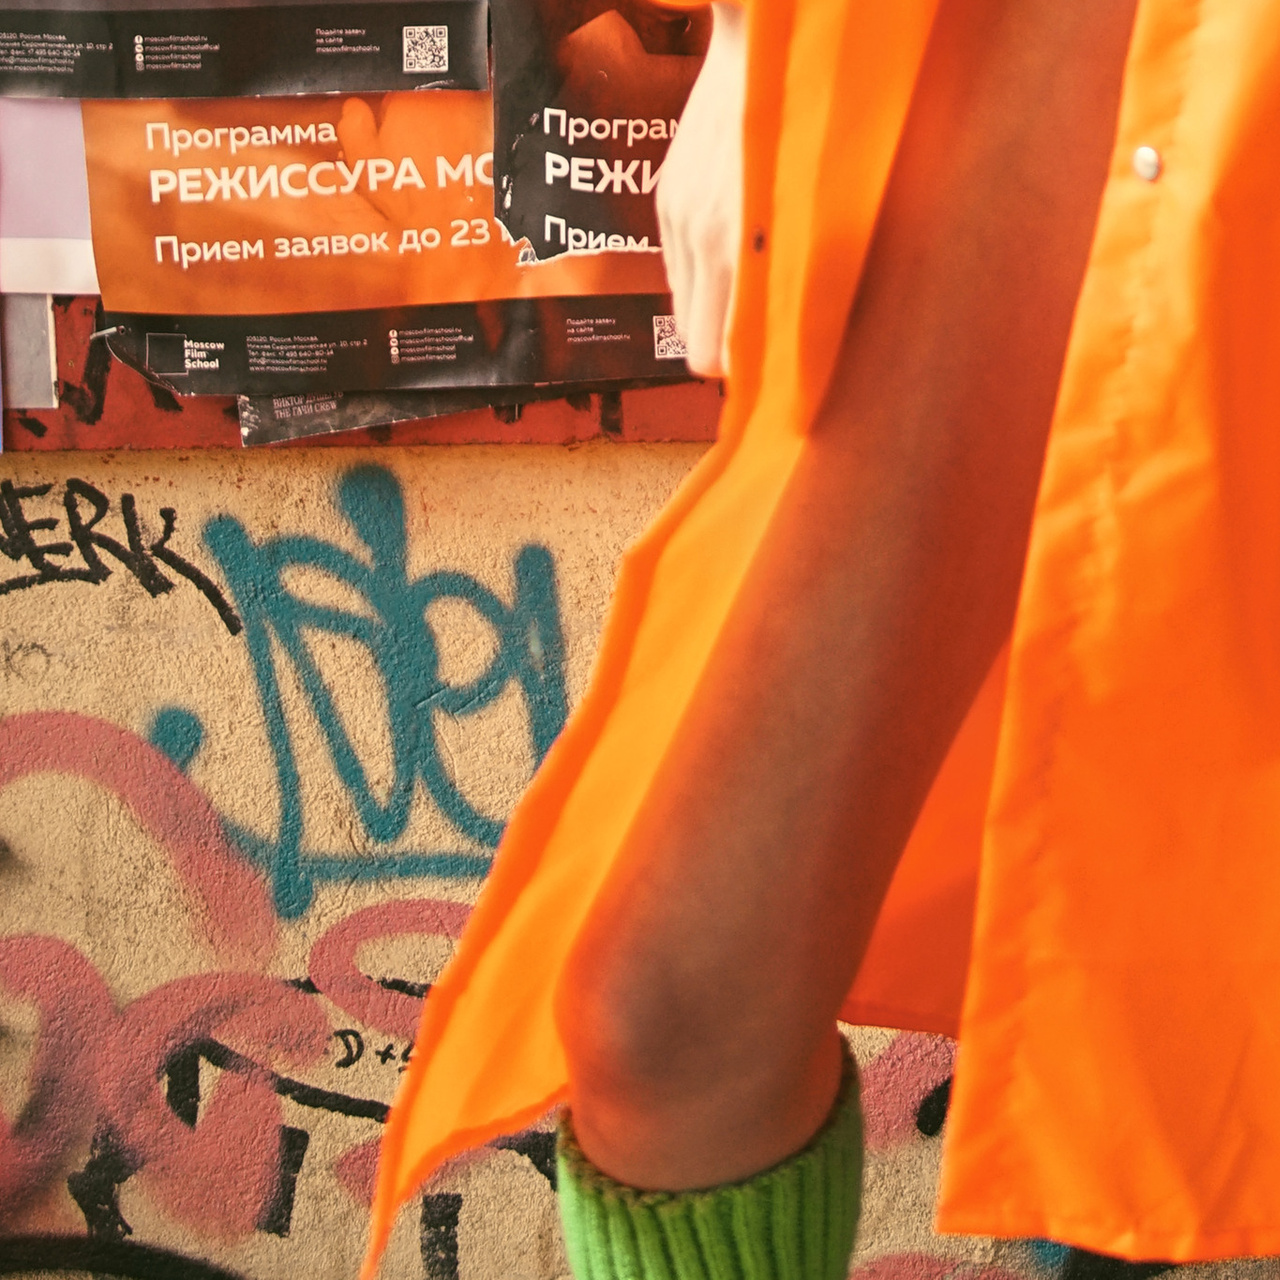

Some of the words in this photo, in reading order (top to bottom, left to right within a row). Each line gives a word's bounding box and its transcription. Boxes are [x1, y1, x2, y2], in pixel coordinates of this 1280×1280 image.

[145, 121, 338, 158] Программа
[149, 156, 426, 204] РЕЖИССУРА
[154, 234, 265, 271] Прием
[273, 230, 390, 258] заявок
[398, 225, 442, 255] до
[449, 217, 492, 248] 23
[184, 338, 226, 351] Moscow
[184, 348, 208, 360] Film
[184, 357, 220, 371] School
